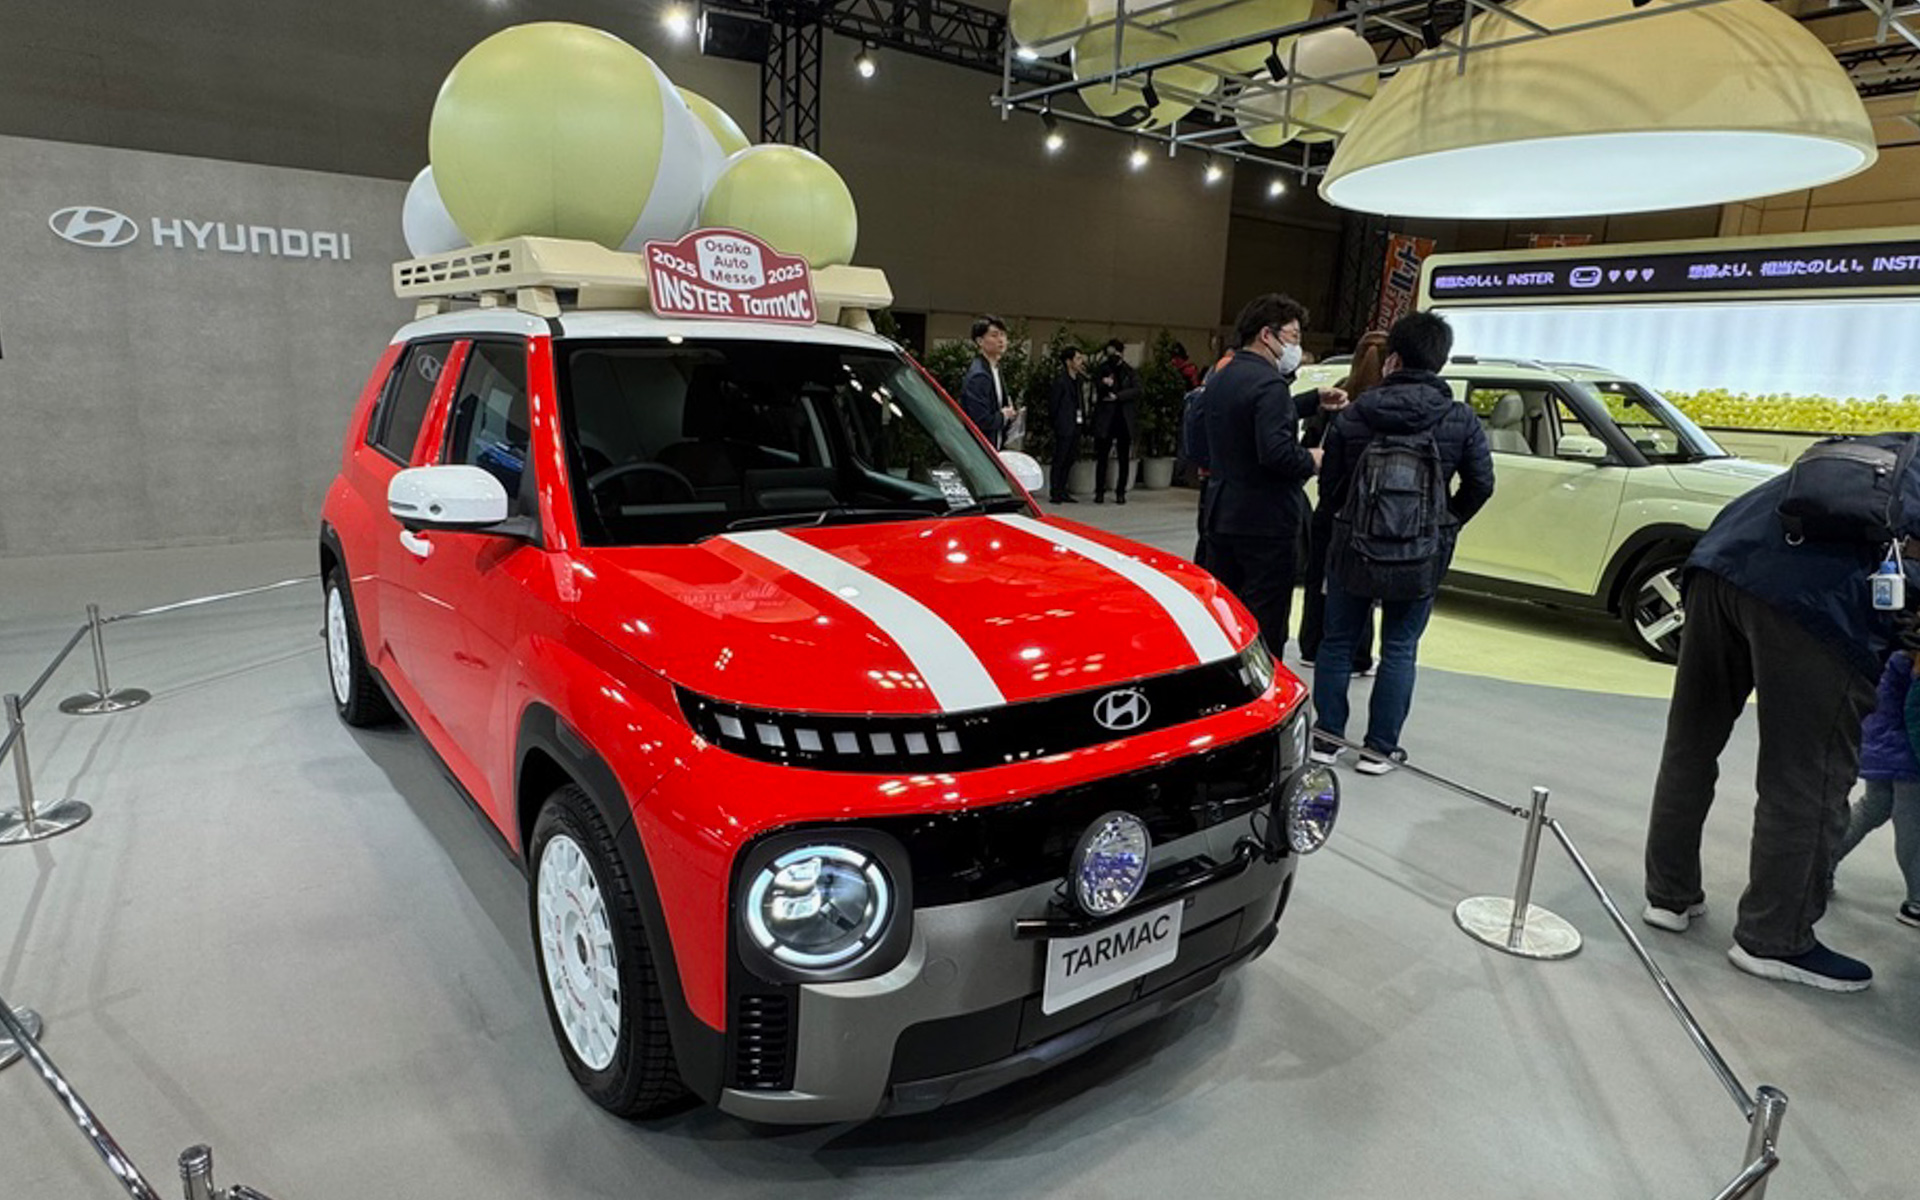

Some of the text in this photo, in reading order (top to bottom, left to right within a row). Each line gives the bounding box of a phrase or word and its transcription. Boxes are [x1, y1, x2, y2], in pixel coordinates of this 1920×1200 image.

[151, 217, 352, 260] HYUNDAI
[704, 239, 752, 255] Osaka
[652, 248, 698, 278] 2025
[713, 255, 749, 269] Auto
[1872, 255, 1920, 271] INST
[709, 269, 757, 286] Messe
[767, 263, 804, 284] 2025
[1507, 272, 1555, 286] INSTER
[655, 268, 812, 319] INSTER Tarmac
[1062, 914, 1170, 977] TARMAC
